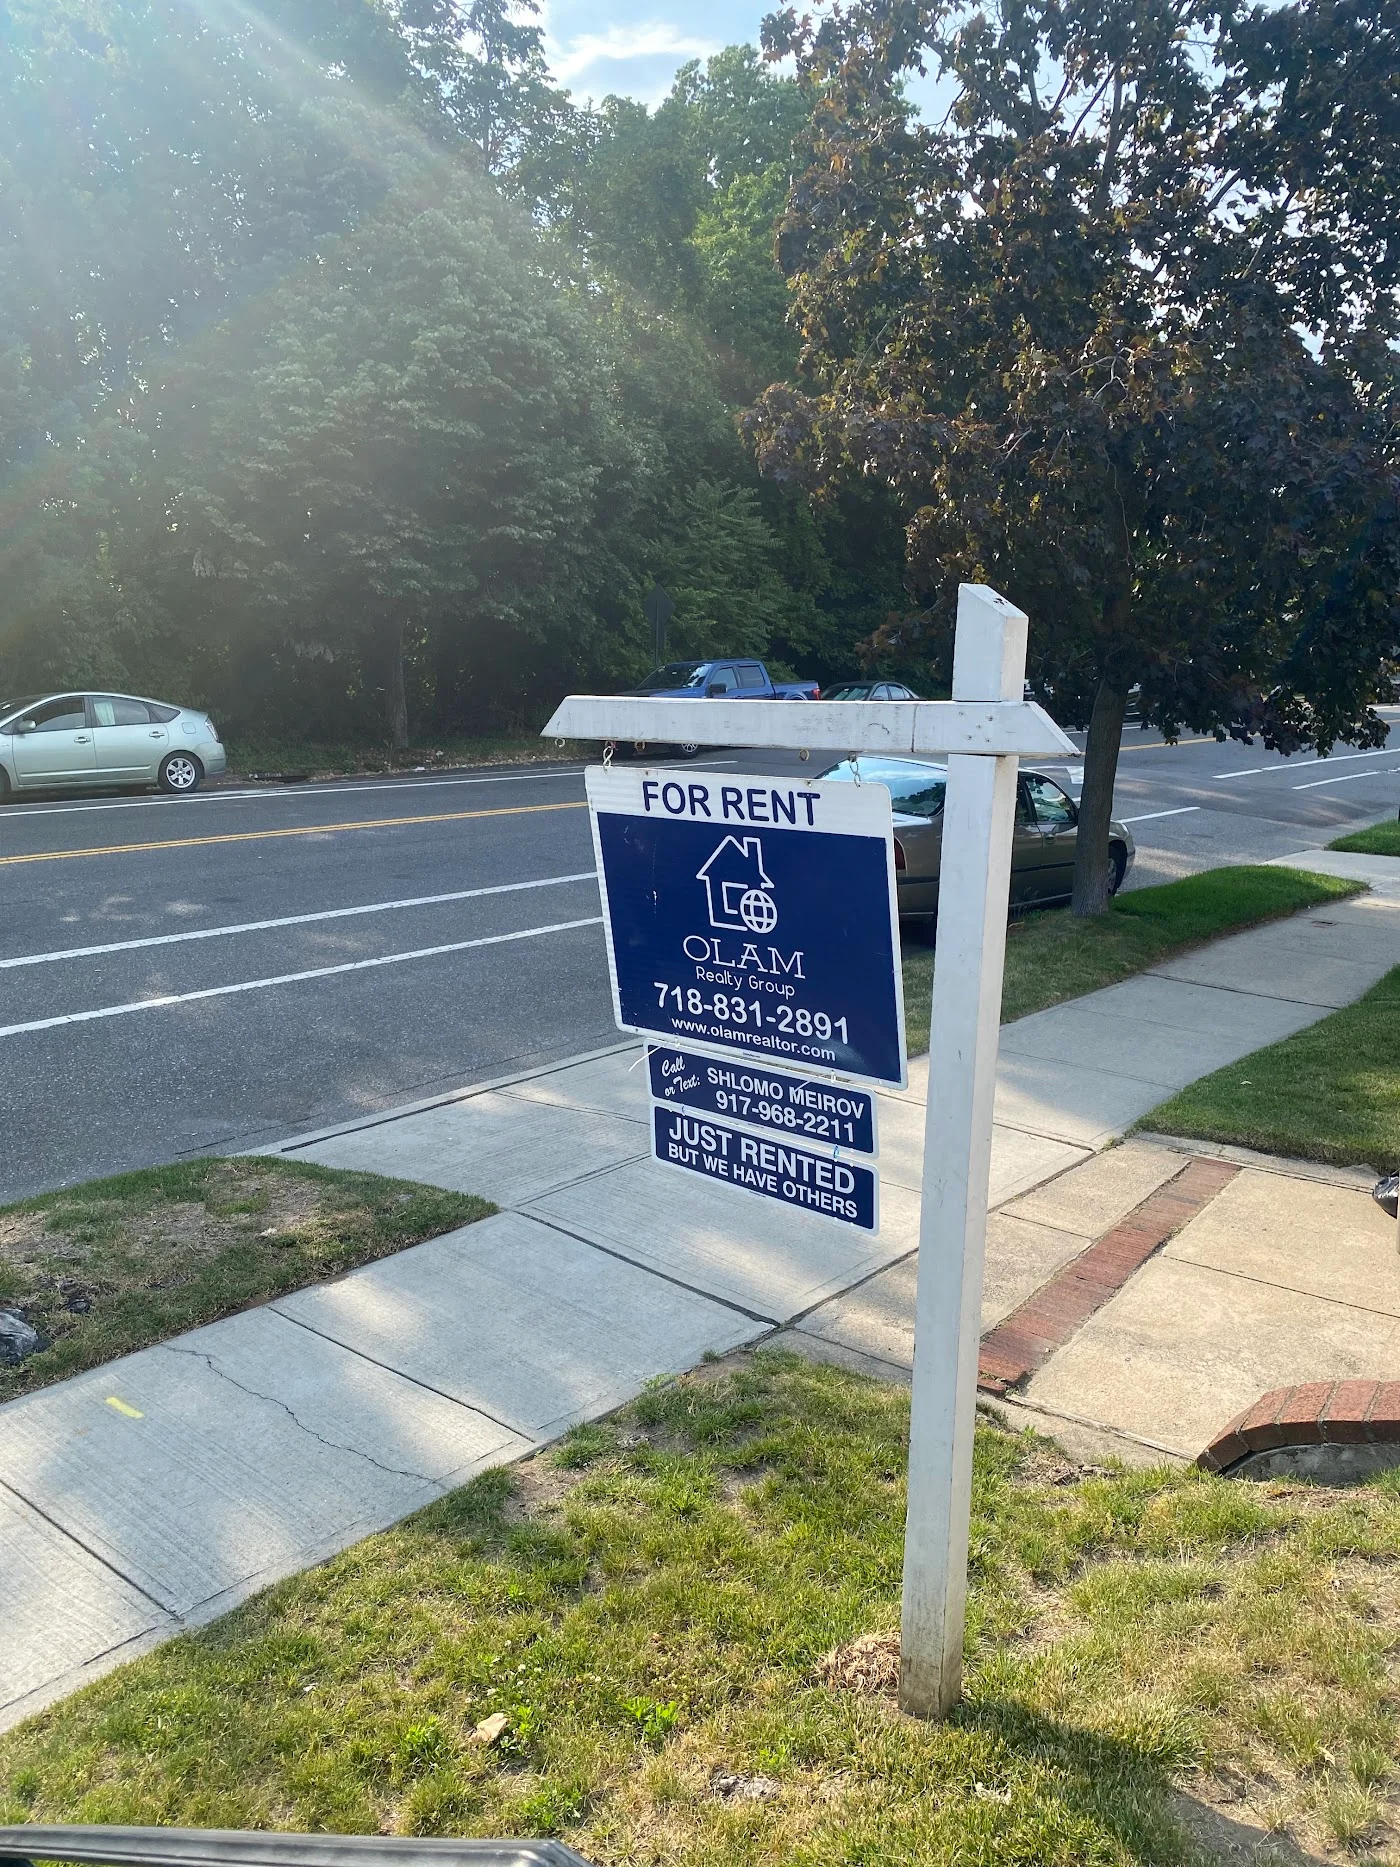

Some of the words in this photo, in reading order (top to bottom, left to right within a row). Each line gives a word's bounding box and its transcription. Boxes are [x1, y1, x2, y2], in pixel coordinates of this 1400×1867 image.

[643, 780, 711, 818] FOR
[721, 787, 821, 826] RENT
[683, 935, 806, 979] OLAM
[695, 966, 743, 990] Realty
[749, 976, 795, 1000] Group
[654, 982, 849, 1044] 718-831-2891
[671, 1017, 836, 1061] www.olamrealtor.com
[662, 1056, 686, 1077] Call
[665, 1085, 676, 1097] or
[673, 1075, 701, 1094] Text:
[707, 1067, 783, 1100] SHLOMO
[789, 1086, 865, 1120] MEIROV
[716, 1091, 854, 1143] 917-968-2211
[669, 1117, 733, 1156] JUST
[741, 1137, 855, 1194] RENTED
[668, 1142, 699, 1166] BUT
[702, 1154, 729, 1177] WE
[733, 1164, 778, 1193] HAVE
[782, 1180, 858, 1219] OTHERS
